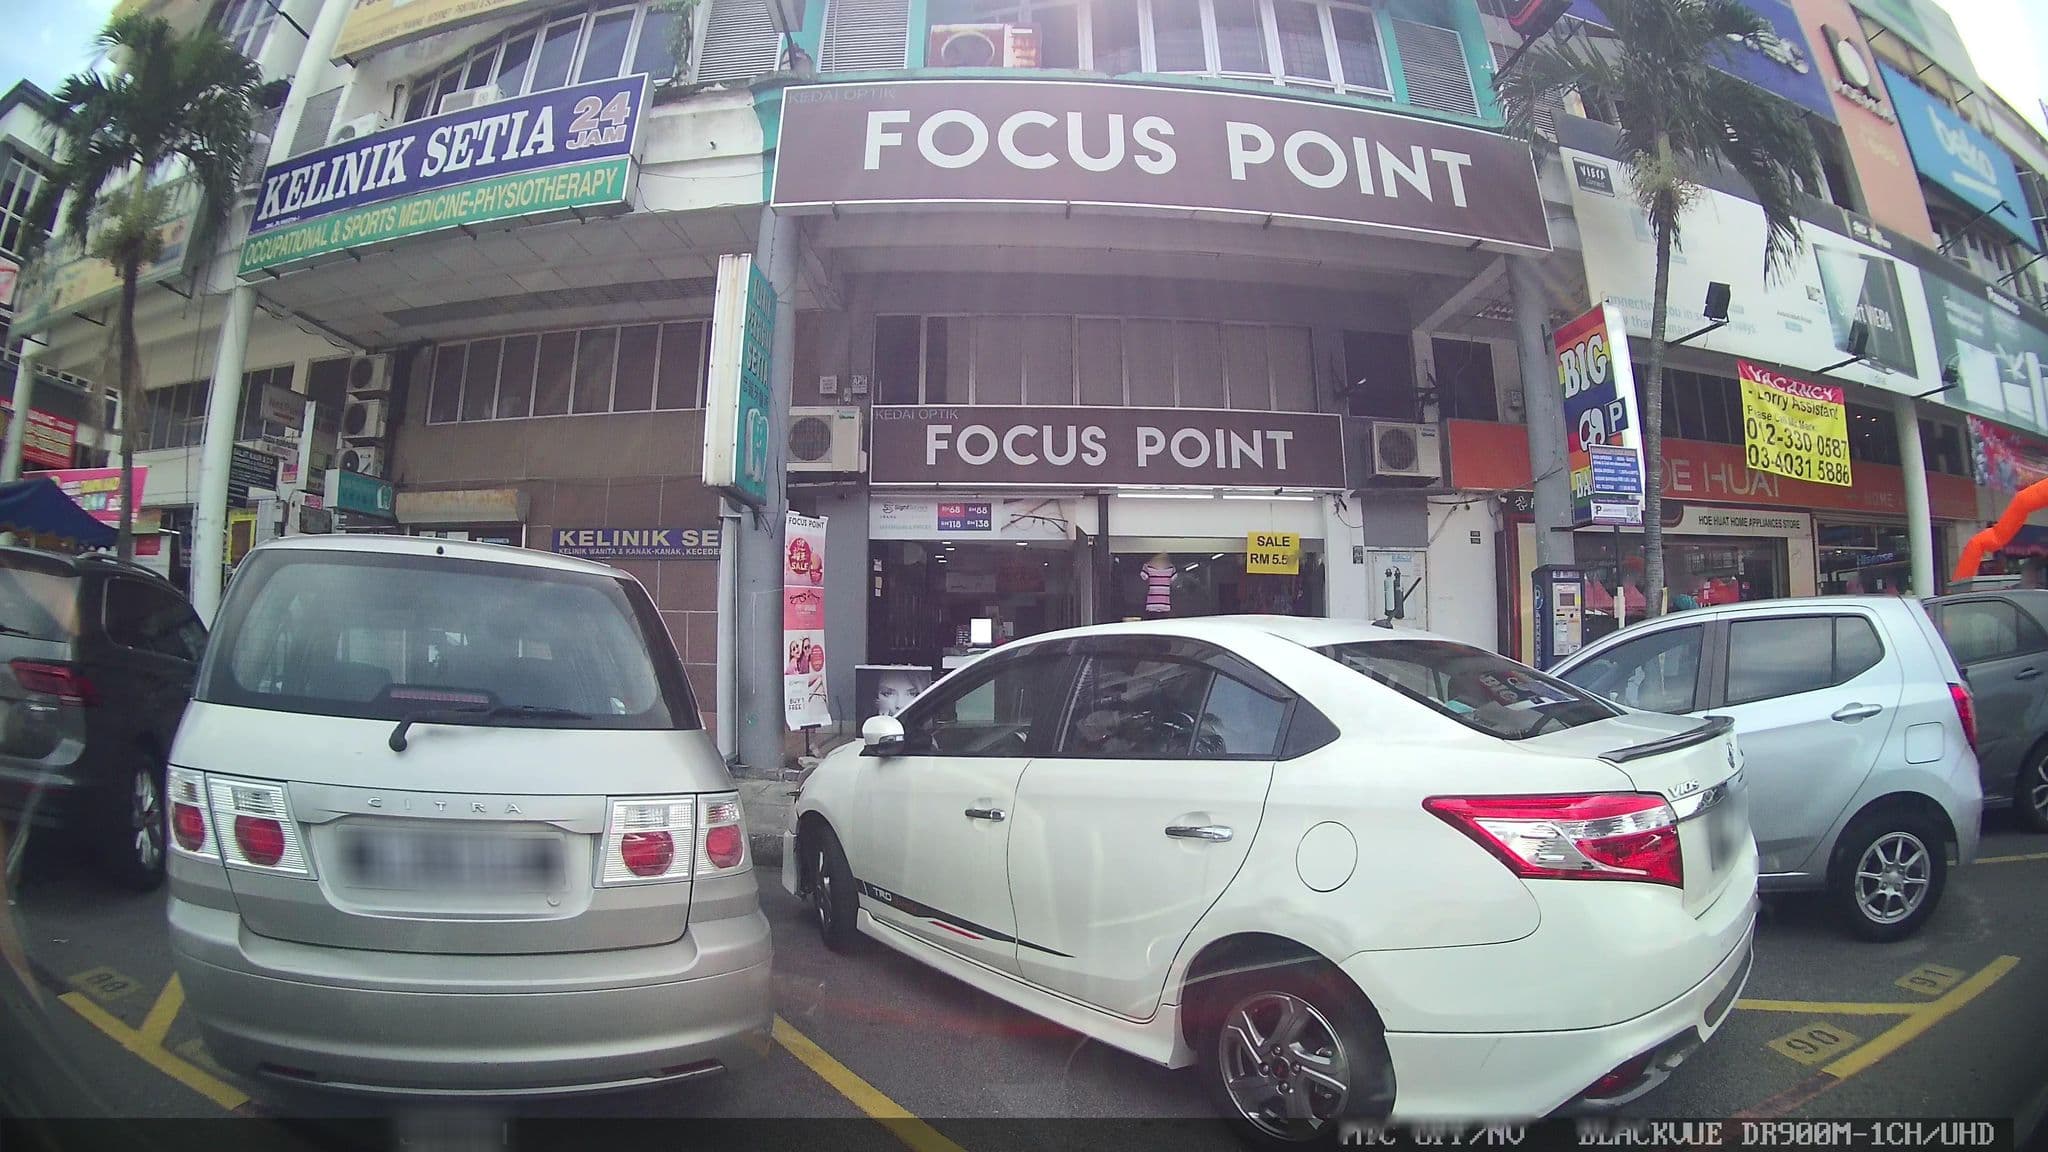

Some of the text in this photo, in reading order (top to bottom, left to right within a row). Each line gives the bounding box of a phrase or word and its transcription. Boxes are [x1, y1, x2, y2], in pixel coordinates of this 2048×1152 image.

[788, 87, 897, 104] KEDAI OPTIK
[569, 91, 630, 133] 24
[566, 125, 627, 149] JAM
[257, 106, 554, 221] KELINIK SETIA
[863, 109, 1472, 208] FOCUS POINT
[245, 166, 618, 266] OCCUPATIONAL & SPORTS MEDICINE-PHYSIOTHERAPY
[1560, 334, 1607, 398] BIG
[1748, 365, 1833, 400] VACANCY
[874, 409, 959, 420] KEDAI OPTIK
[1758, 391, 1838, 420] Lorry Assistant
[927, 424, 1295, 470] FOCUS POINT
[1817, 435, 1847, 459] 0587
[1748, 444, 1811, 478] 03-4031
[789, 516, 824, 528] FOCUS POINT
[1699, 516, 1712, 526] HOE
[1713, 516, 1730, 526] HUAT
[1731, 517, 1747, 527] HOME
[1783, 520, 1800, 530] STORE
[559, 530, 719, 546] KELINIK SE
[1257, 536, 1290, 547] SALE
[792, 562, 808, 570] SALE
[1250, 554, 1291, 565] RM 5.5
[368, 797, 522, 814] CITRA
[873, 886, 891, 901] TRD
[1786, 1029, 1840, 1055] 90
